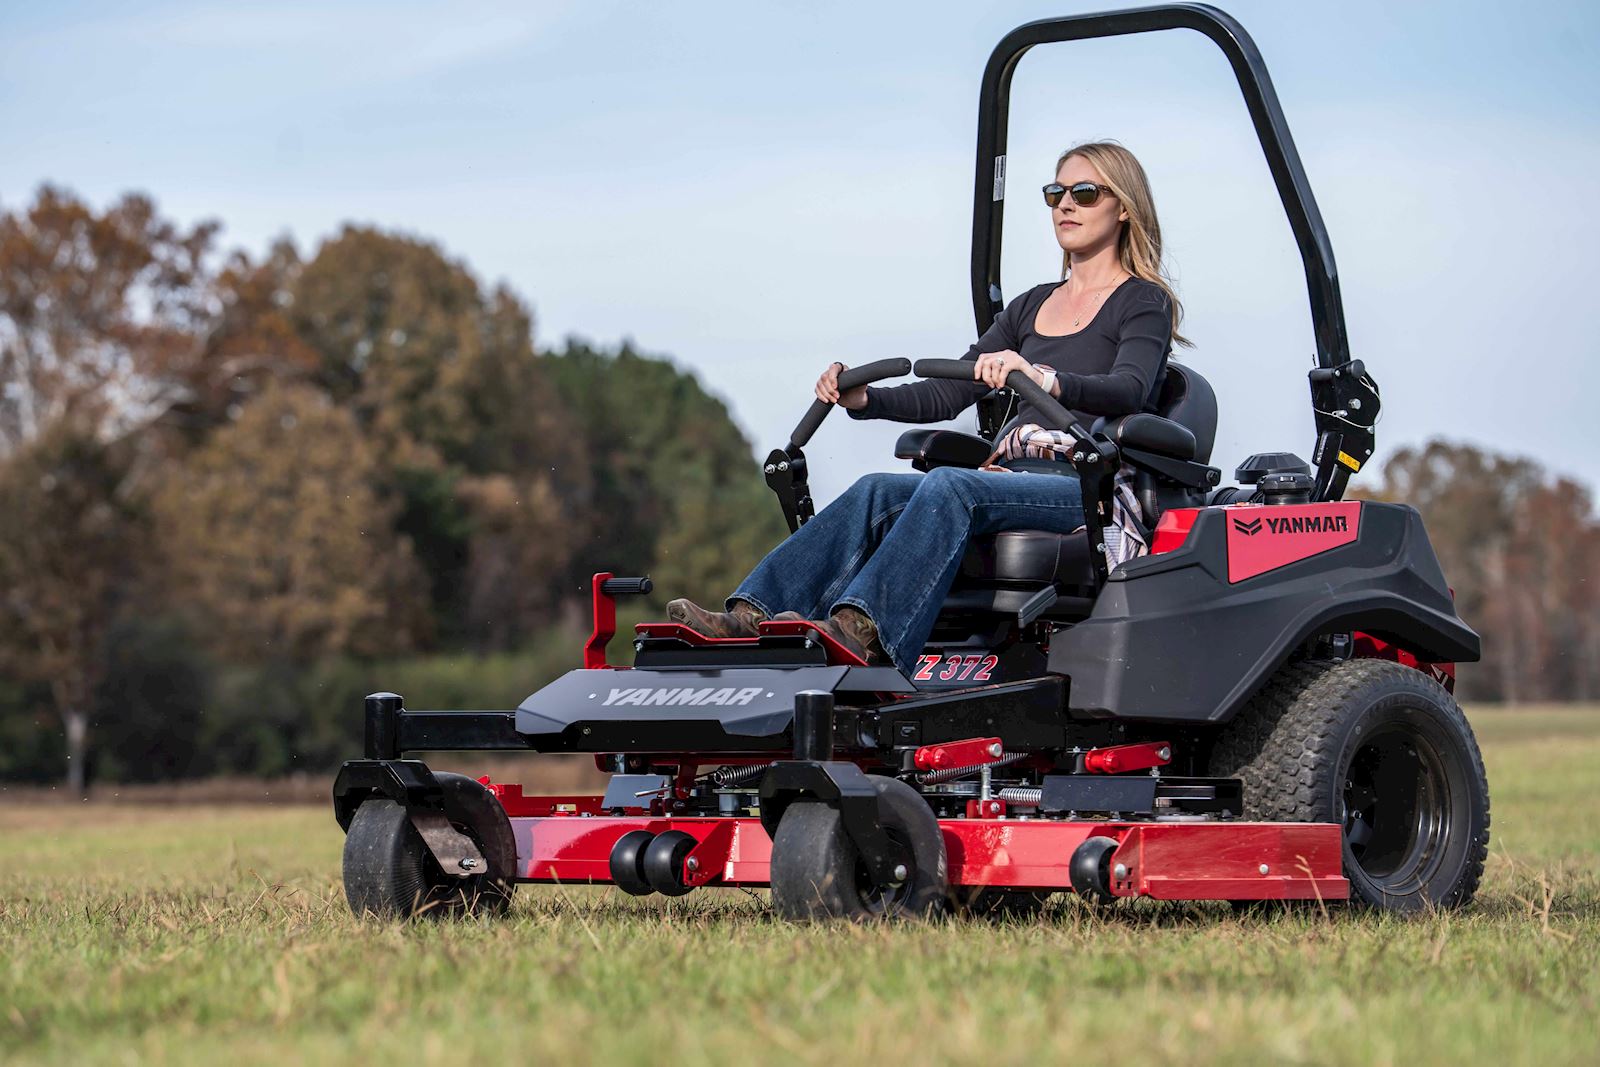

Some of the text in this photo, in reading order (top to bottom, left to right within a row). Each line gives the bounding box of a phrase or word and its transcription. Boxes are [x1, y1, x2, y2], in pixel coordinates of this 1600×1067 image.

[1265, 516, 1349, 534] YANMAR
[914, 654, 999, 681] Z 372
[602, 687, 763, 706] YANMAR
